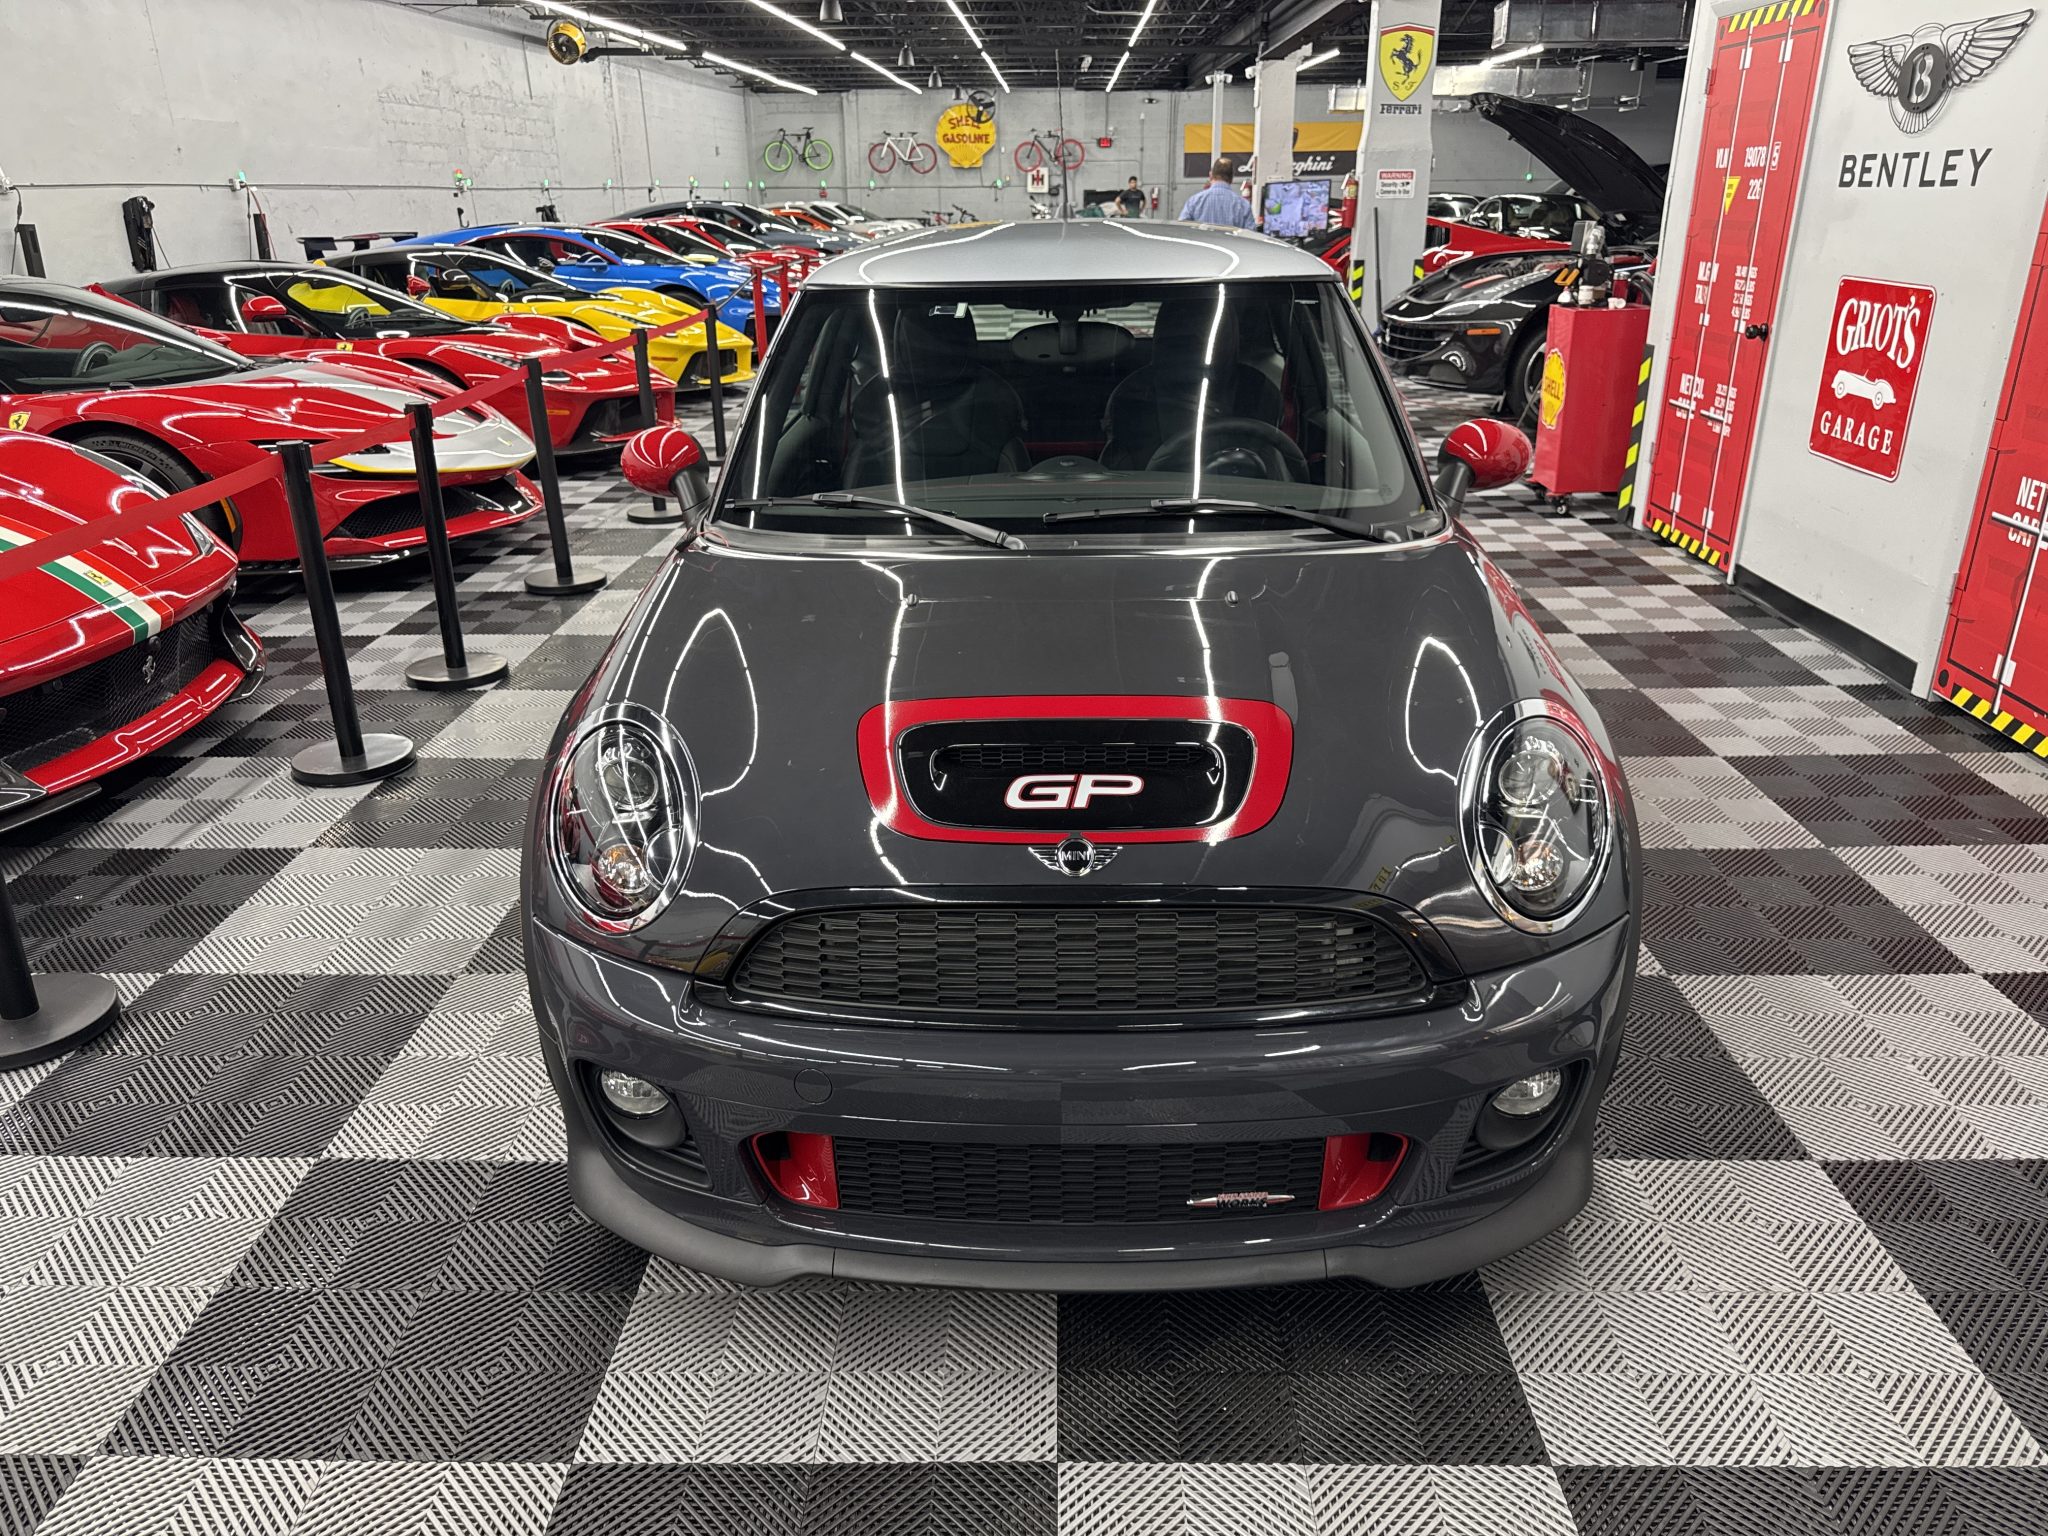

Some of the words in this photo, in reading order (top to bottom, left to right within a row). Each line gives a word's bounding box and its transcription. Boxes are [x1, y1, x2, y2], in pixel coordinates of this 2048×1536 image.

[948, 115, 981, 129] SHEL
[1379, 103, 1422, 115] Ferrari
[942, 133, 990, 144] GASOLINE
[1237, 154, 1335, 176] Lrghini
[1839, 148, 1993, 187] BENTLEY
[1836, 295, 1920, 369] GRIOT'S
[1820, 411, 1894, 455] GARAGE
[2015, 476, 2047, 513] NET
[1004, 774, 1145, 810] GP
[1061, 851, 1092, 861] MINI
